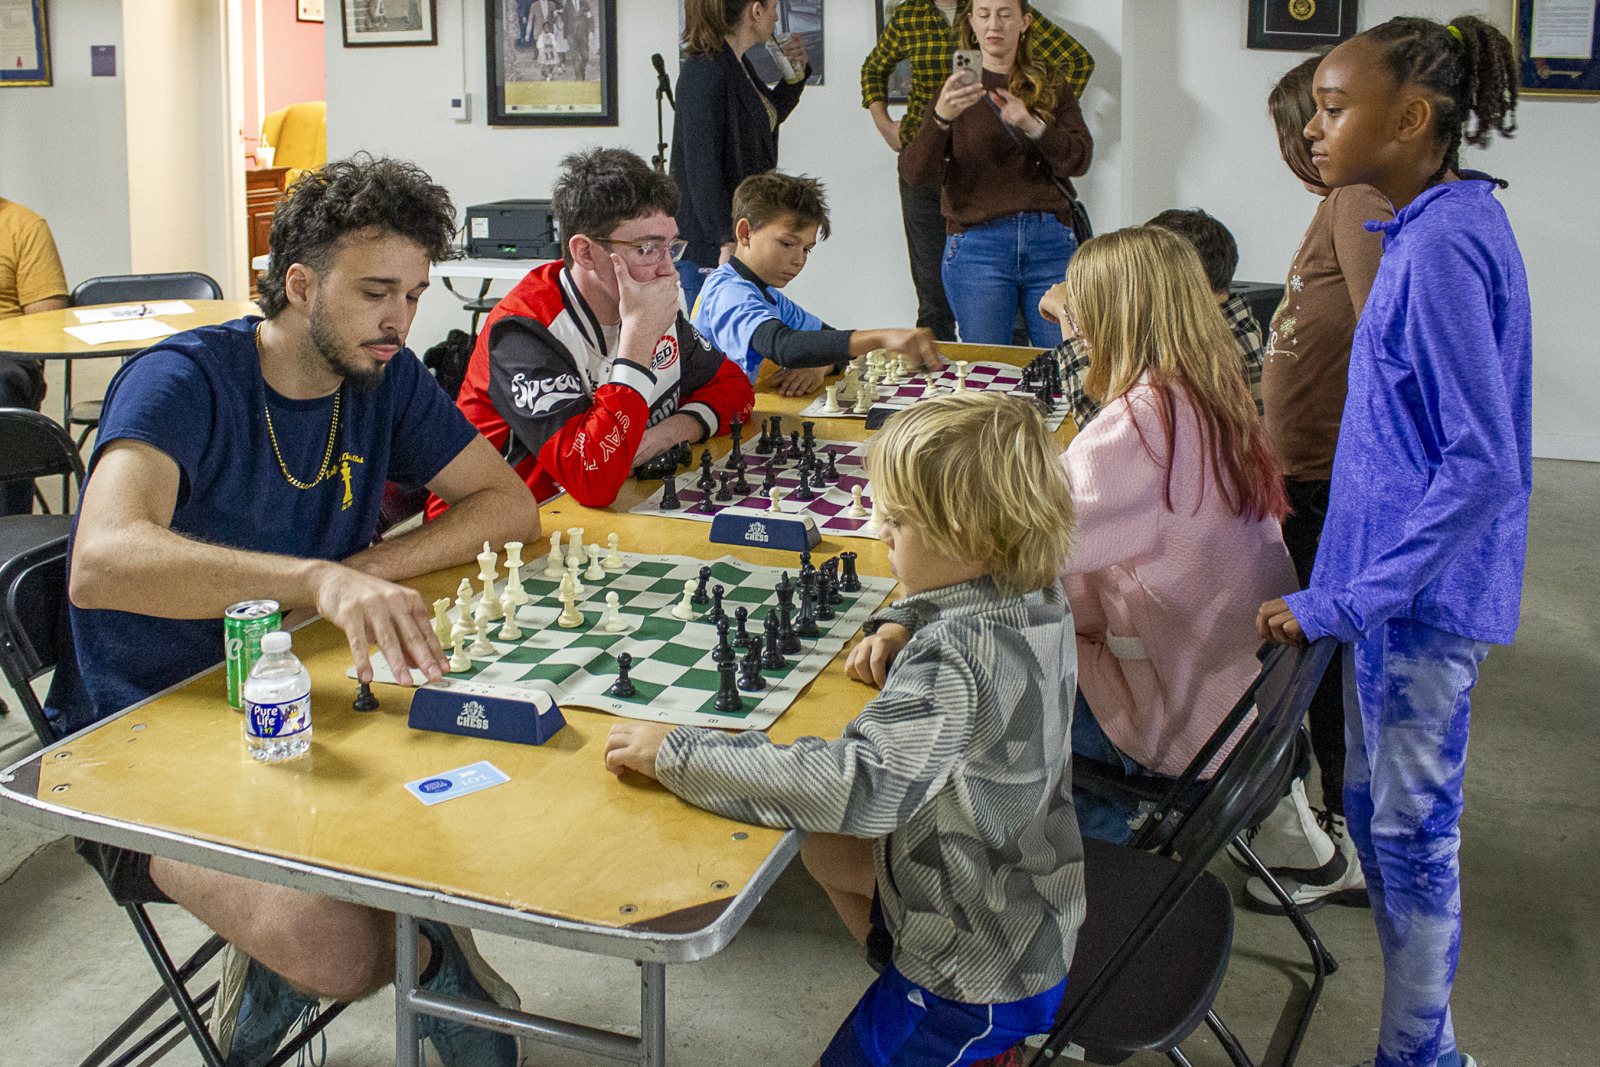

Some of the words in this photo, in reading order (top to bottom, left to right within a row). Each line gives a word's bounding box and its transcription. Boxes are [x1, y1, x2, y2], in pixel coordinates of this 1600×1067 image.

[744, 532, 769, 543] CHESS
[254, 705, 279, 717] Pure
[256, 715, 276, 728] Life
[456, 715, 490, 731] CHESS
